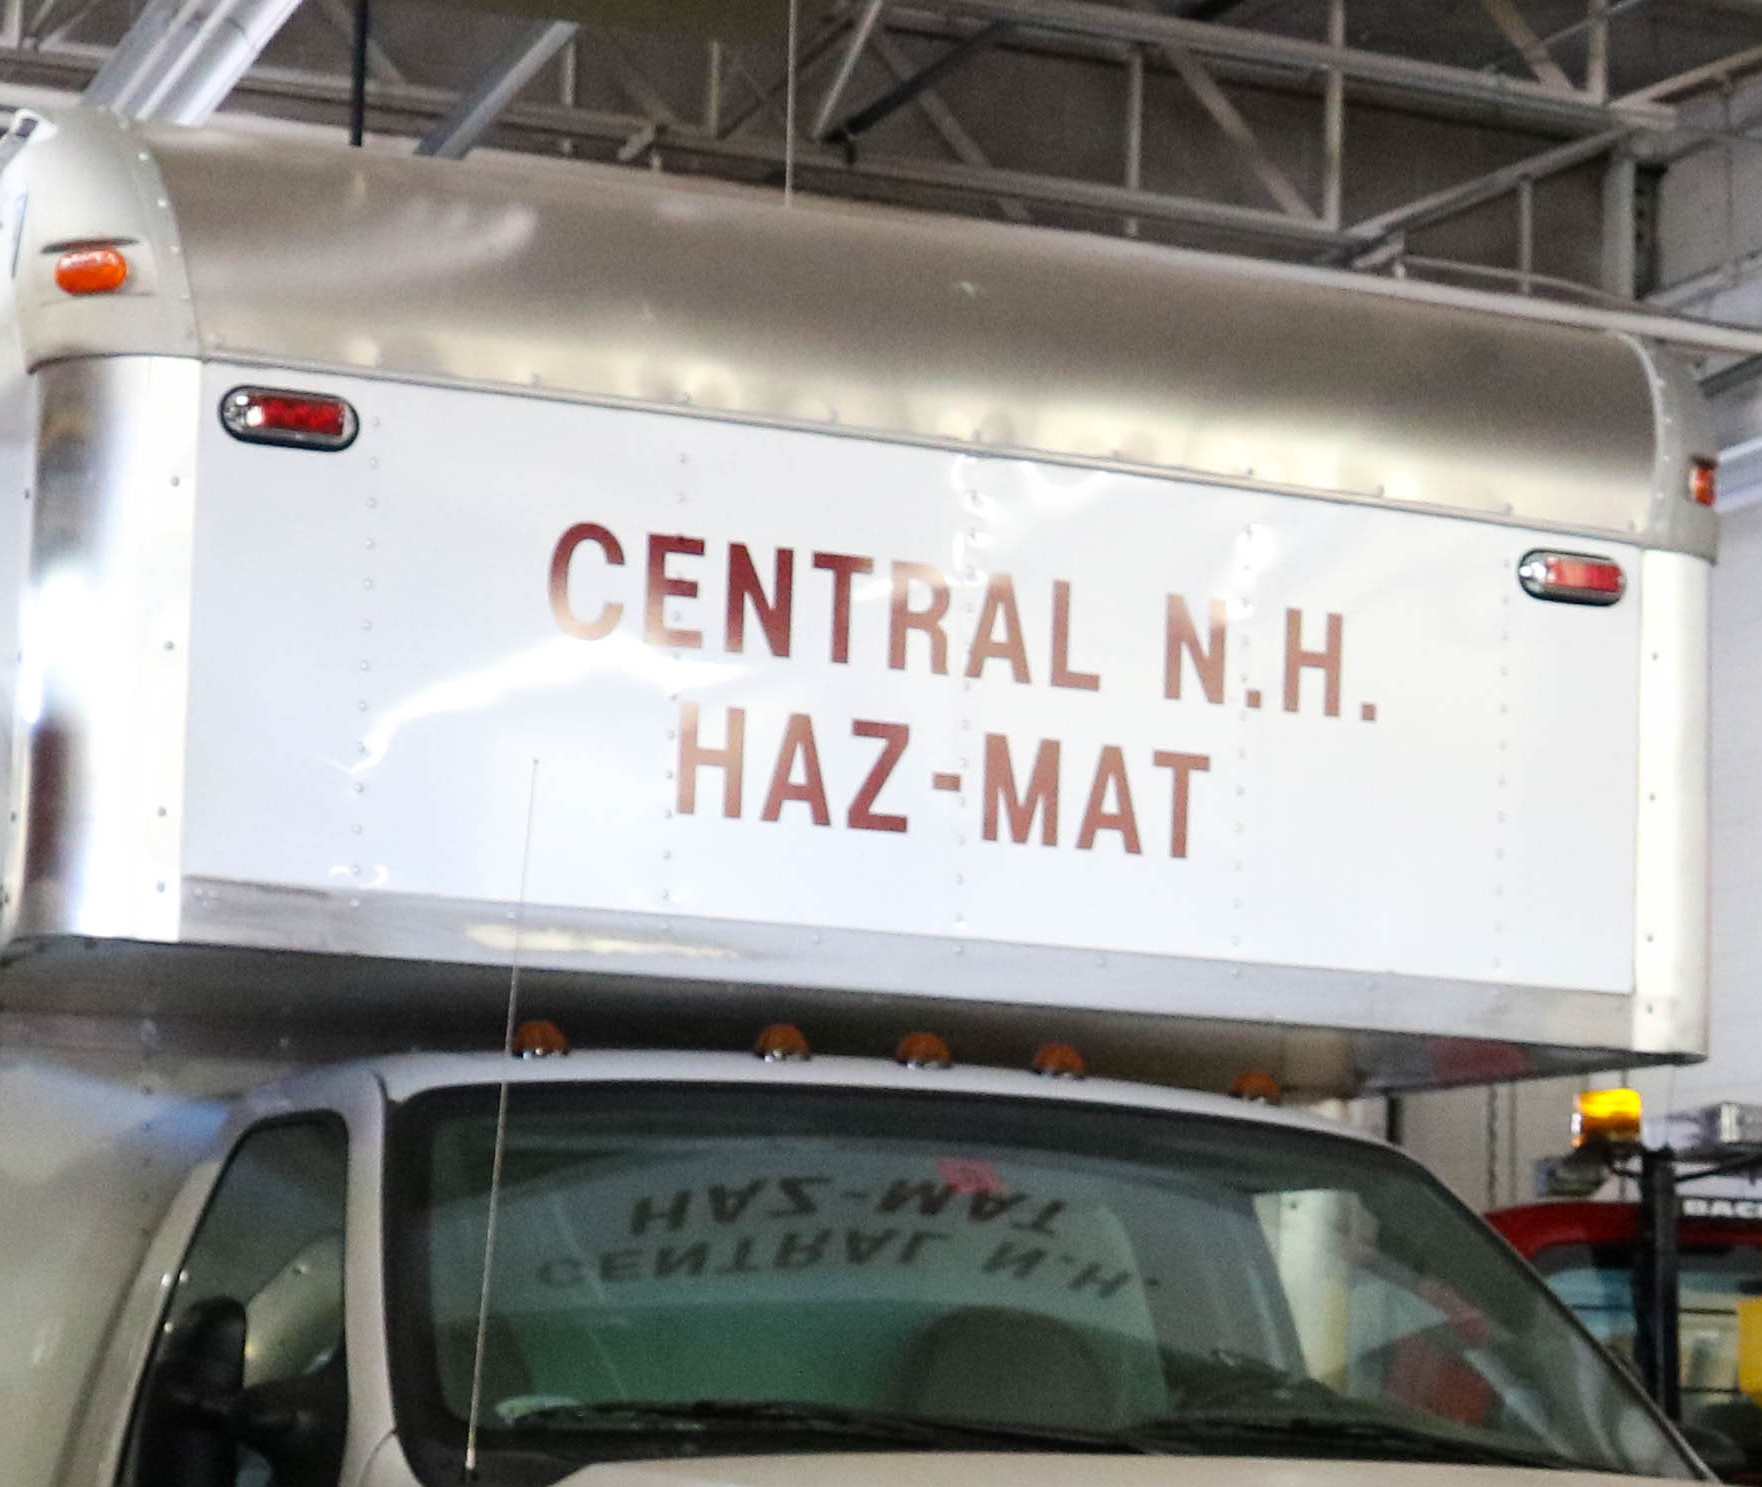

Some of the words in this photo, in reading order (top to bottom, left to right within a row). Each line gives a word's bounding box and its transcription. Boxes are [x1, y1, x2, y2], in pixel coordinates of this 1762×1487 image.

[548, 521, 1100, 692] CENTRAL
[1163, 593, 1378, 722] N.H.
[676, 703, 1211, 859] HAZ-MAT
